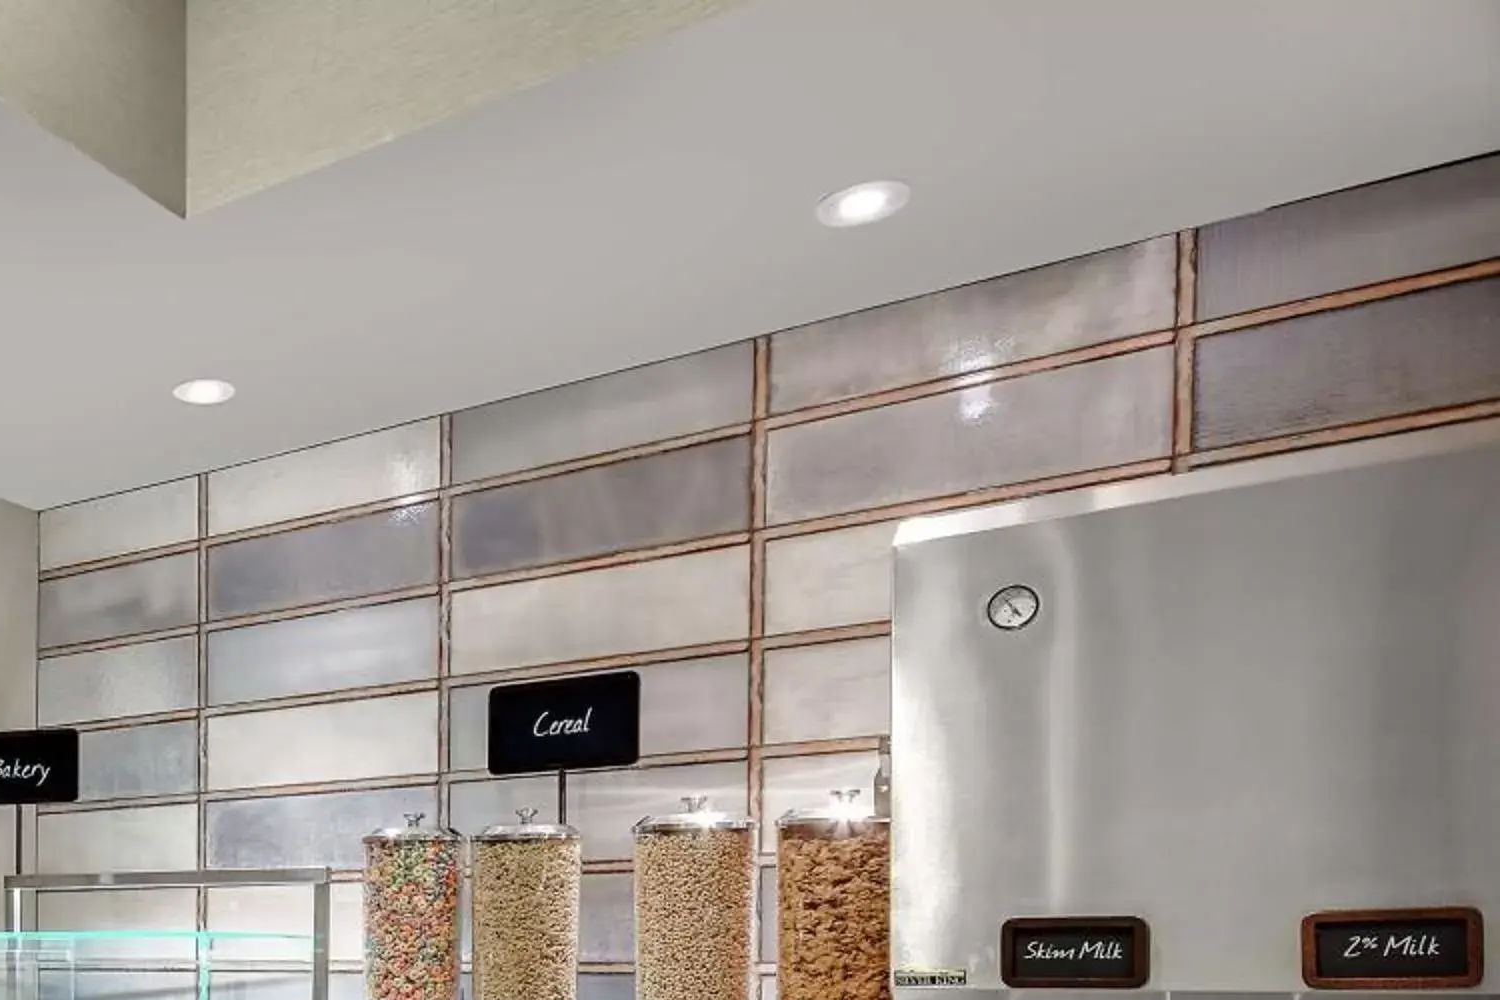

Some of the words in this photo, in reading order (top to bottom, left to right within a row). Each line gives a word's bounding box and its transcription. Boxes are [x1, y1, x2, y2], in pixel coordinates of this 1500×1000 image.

[533, 706, 593, 737] Cereal
[1023, 941, 1075, 960] Skim
[1078, 941, 1123, 960] Milk
[1343, 935, 1378, 958] 2%
[1382, 934, 1440, 957] Milk
